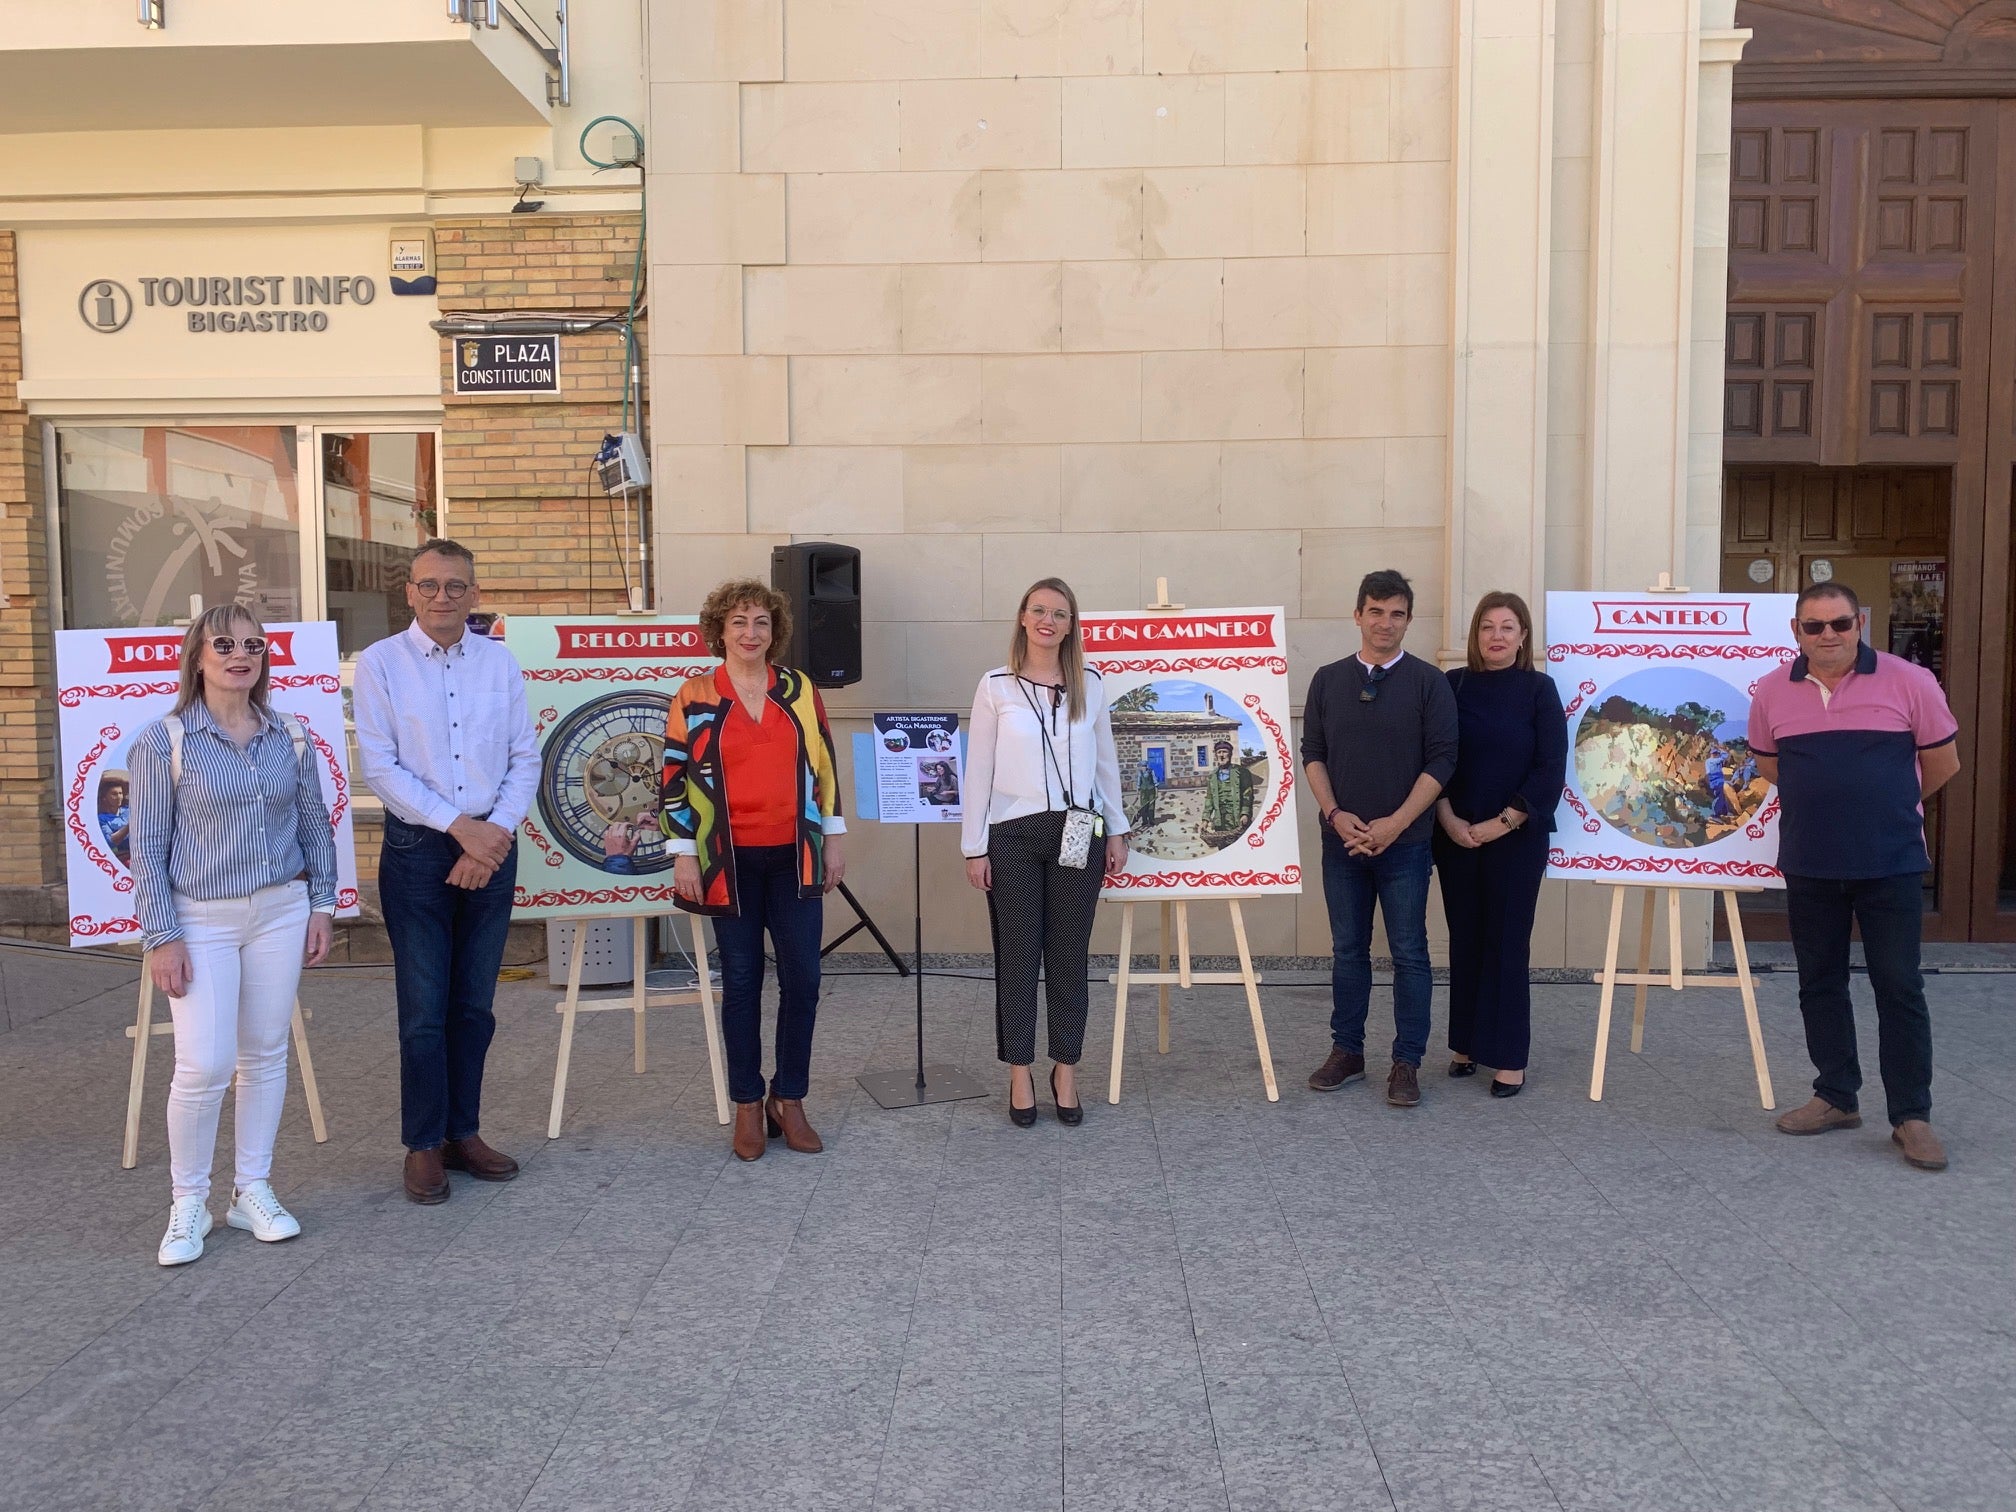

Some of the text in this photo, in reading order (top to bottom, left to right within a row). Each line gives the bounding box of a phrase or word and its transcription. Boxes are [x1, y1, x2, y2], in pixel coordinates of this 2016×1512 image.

[138, 275, 375, 306] TOURIST INFO
[187, 310, 328, 332] BIGASTRO
[494, 344, 551, 362] PLAZA
[461, 368, 551, 384] CONSTITUCION
[1897, 563, 1937, 572] HERMANOS
[1920, 573, 1929, 581] LA
[1931, 573, 1941, 581] FE
[1612, 609, 1728, 626] CANTERO
[1142, 620, 1267, 640] CAMINERO
[571, 631, 698, 648] RELOJERO
